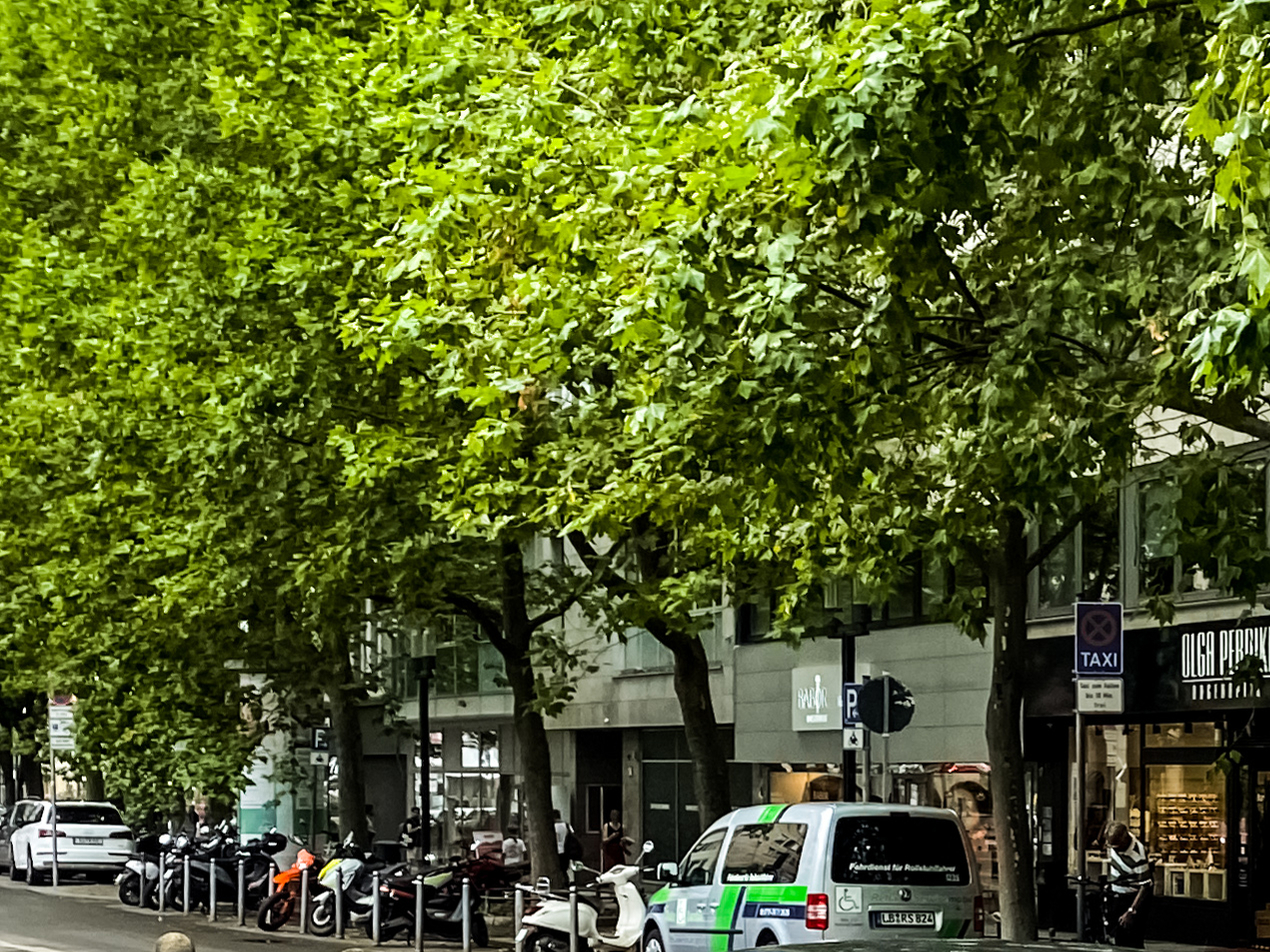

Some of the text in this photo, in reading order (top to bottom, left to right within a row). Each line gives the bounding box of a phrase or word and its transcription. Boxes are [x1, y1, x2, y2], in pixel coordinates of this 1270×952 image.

[1080, 651, 1118, 667] TAXI
[1182, 631, 1215, 678] OLGA
[846, 689, 858, 719] P
[901, 913, 914, 923] RS
